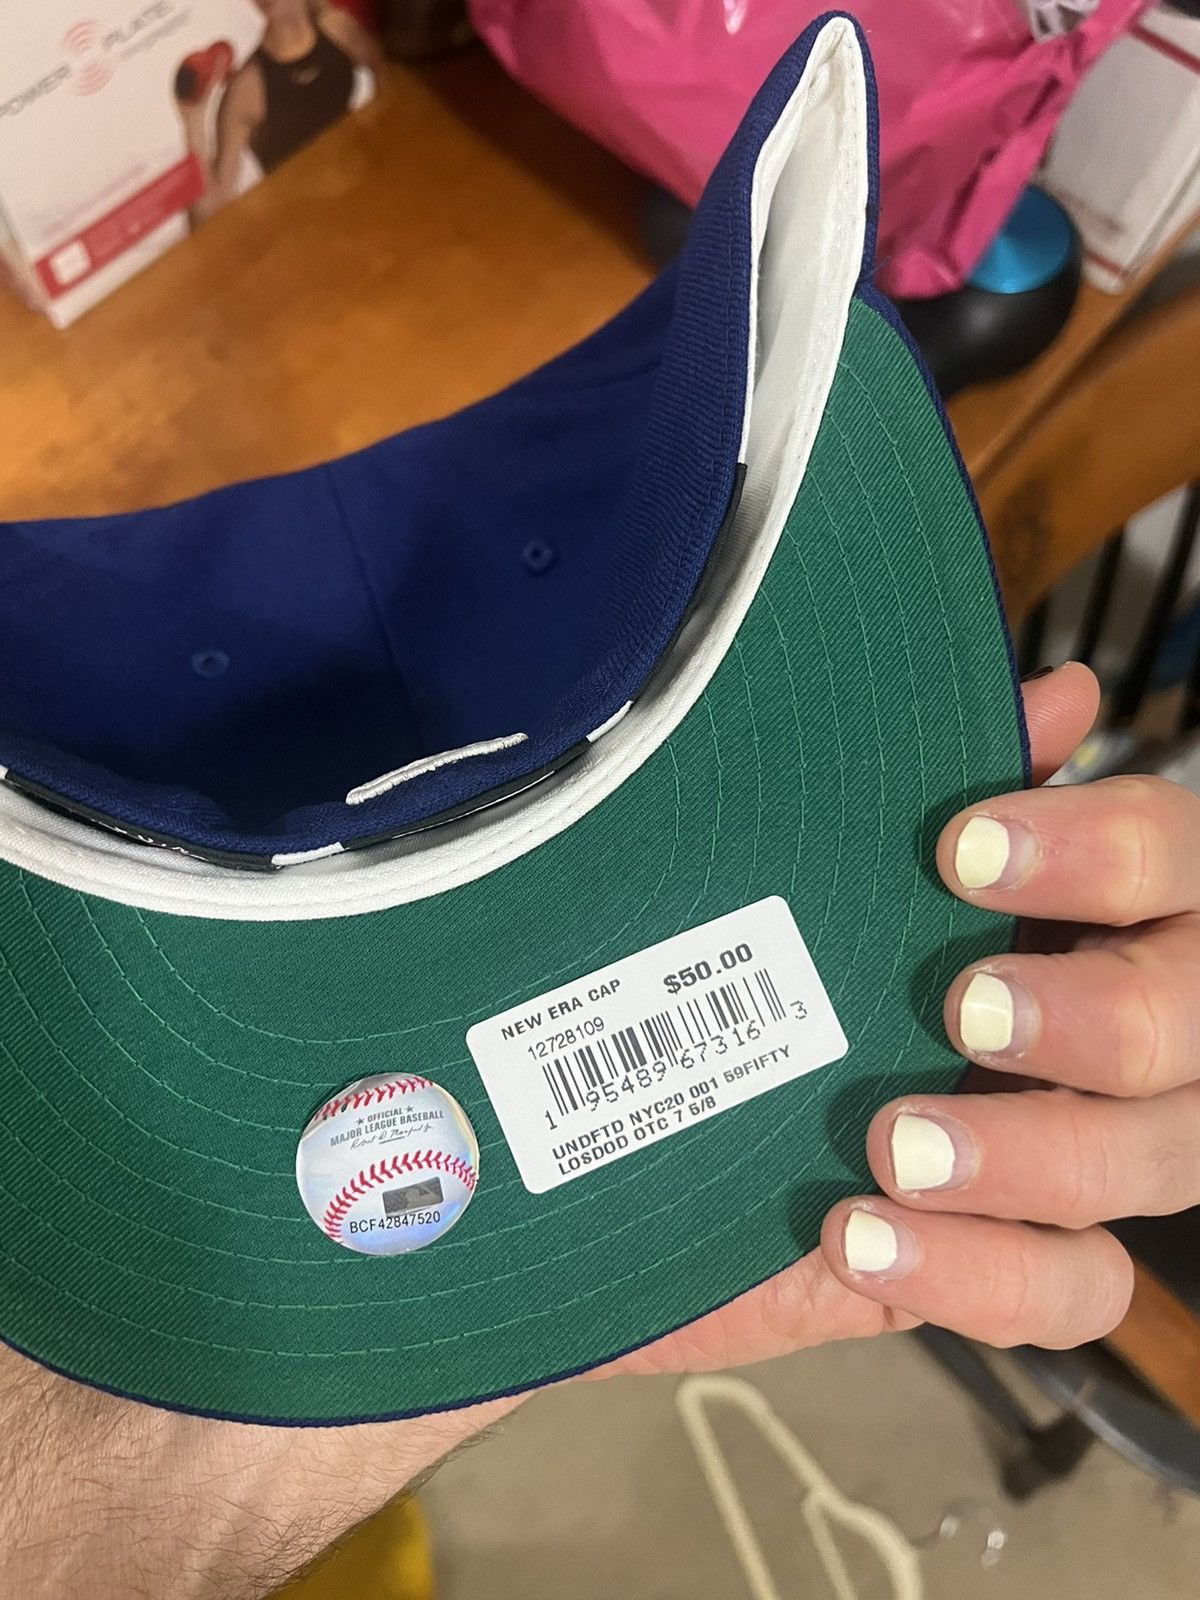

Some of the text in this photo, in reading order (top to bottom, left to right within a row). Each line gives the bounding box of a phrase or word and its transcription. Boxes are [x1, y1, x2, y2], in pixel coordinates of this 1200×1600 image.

[662, 942, 754, 996] $50.00
[501, 978, 622, 1041] NEW ERA CAP
[527, 1016, 606, 1061] 12728109
[367, 1107, 403, 1123] OFFICIAL
[551, 1043, 792, 1160] UNDFTD NYC20 001 59FIFTY
[330, 1109, 445, 1147] MAJOR LEAGUE BASEBALL
[558, 1095, 717, 1176] LOSDOD OTC 7 5/8
[350, 1210, 442, 1234] BCF42847520
